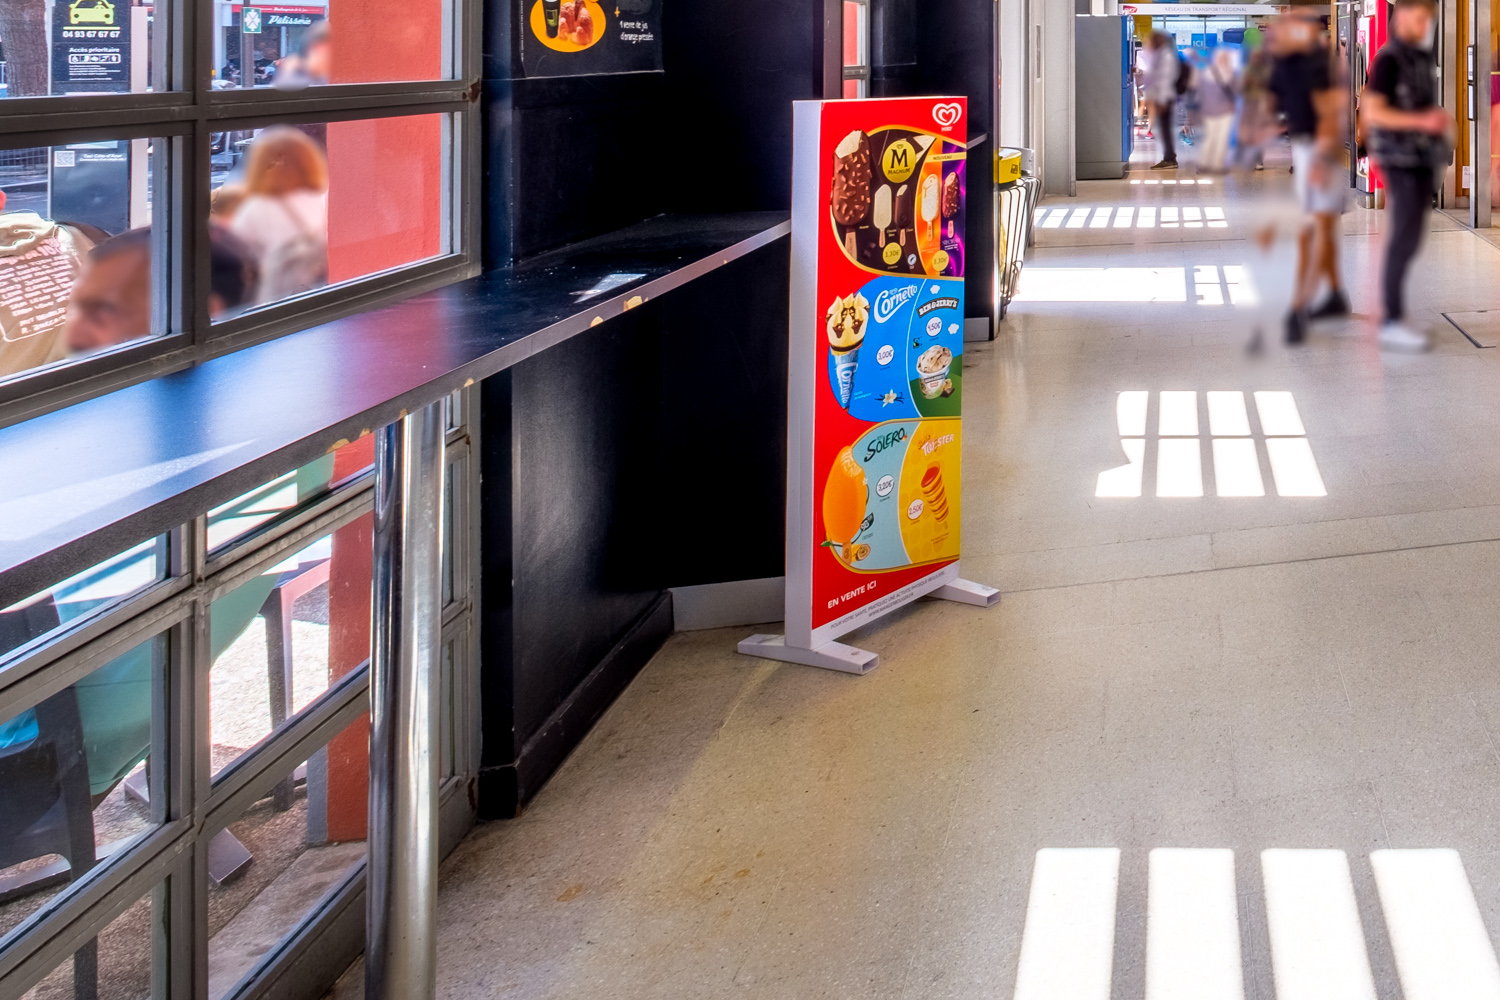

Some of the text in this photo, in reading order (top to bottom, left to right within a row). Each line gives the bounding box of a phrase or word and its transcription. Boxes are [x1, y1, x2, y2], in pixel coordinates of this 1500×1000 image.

[87, 46, 120, 55] prioritaire
[890, 148, 909, 169] M
[887, 168, 911, 176] MAGNUM
[874, 284, 918, 324] Cornetto
[863, 427, 906, 463] SOLERO
[877, 478, 893, 493] 3,20€
[908, 502, 924, 516] 2,50€
[827, 580, 877, 609] EN VENTE ICI
